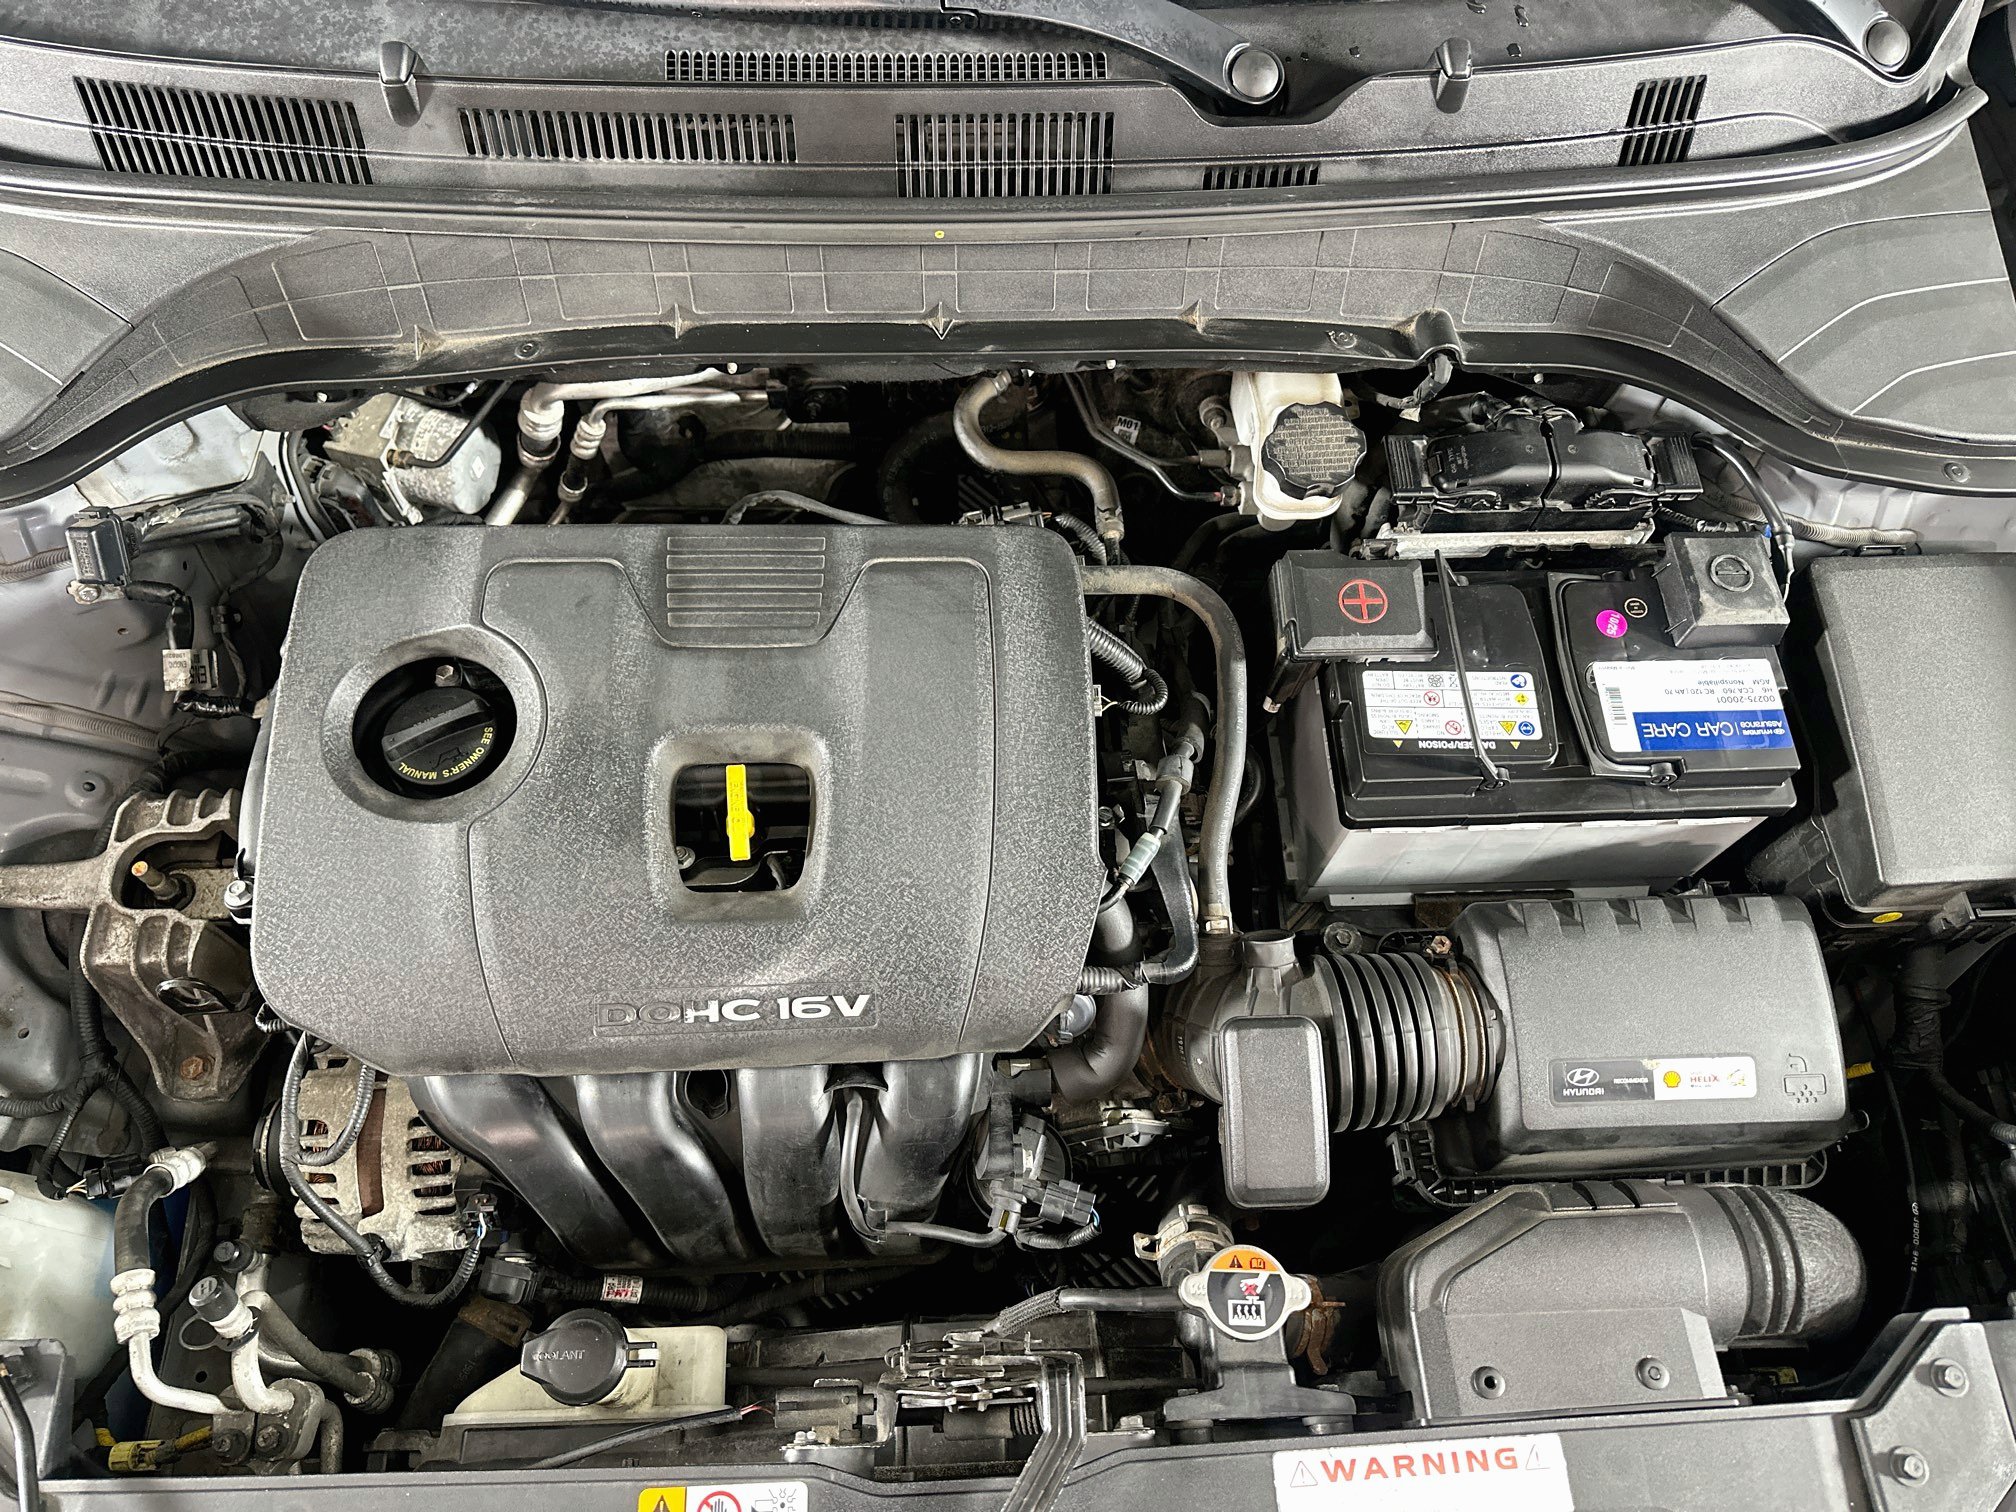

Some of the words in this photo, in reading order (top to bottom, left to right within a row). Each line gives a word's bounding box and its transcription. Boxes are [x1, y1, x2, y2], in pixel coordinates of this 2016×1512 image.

[1118, 417, 1139, 430] M01
[1606, 613, 1620, 635] 10/25
[1697, 678, 1744, 686] Nonspillable
[1717, 695, 1776, 704] 00275-20001
[1641, 722, 1691, 738] CARE
[1697, 722, 1734, 736] CAR
[1740, 720, 1783, 728] Assurance
[481, 727, 493, 745] SEE
[1418, 740, 1496, 750] DAGER/POISON
[442, 747, 485, 777] OWNER'S
[398, 762, 437, 780] MANUAL
[596, 999, 761, 1027] DOHC
[777, 994, 871, 1020] 16V
[1690, 1074, 1719, 1083] HELIX
[1563, 1087, 1604, 1096] HYUNDAI
[532, 1349, 585, 1361] COOLANT
[1320, 1448, 1519, 1483] WARNING
